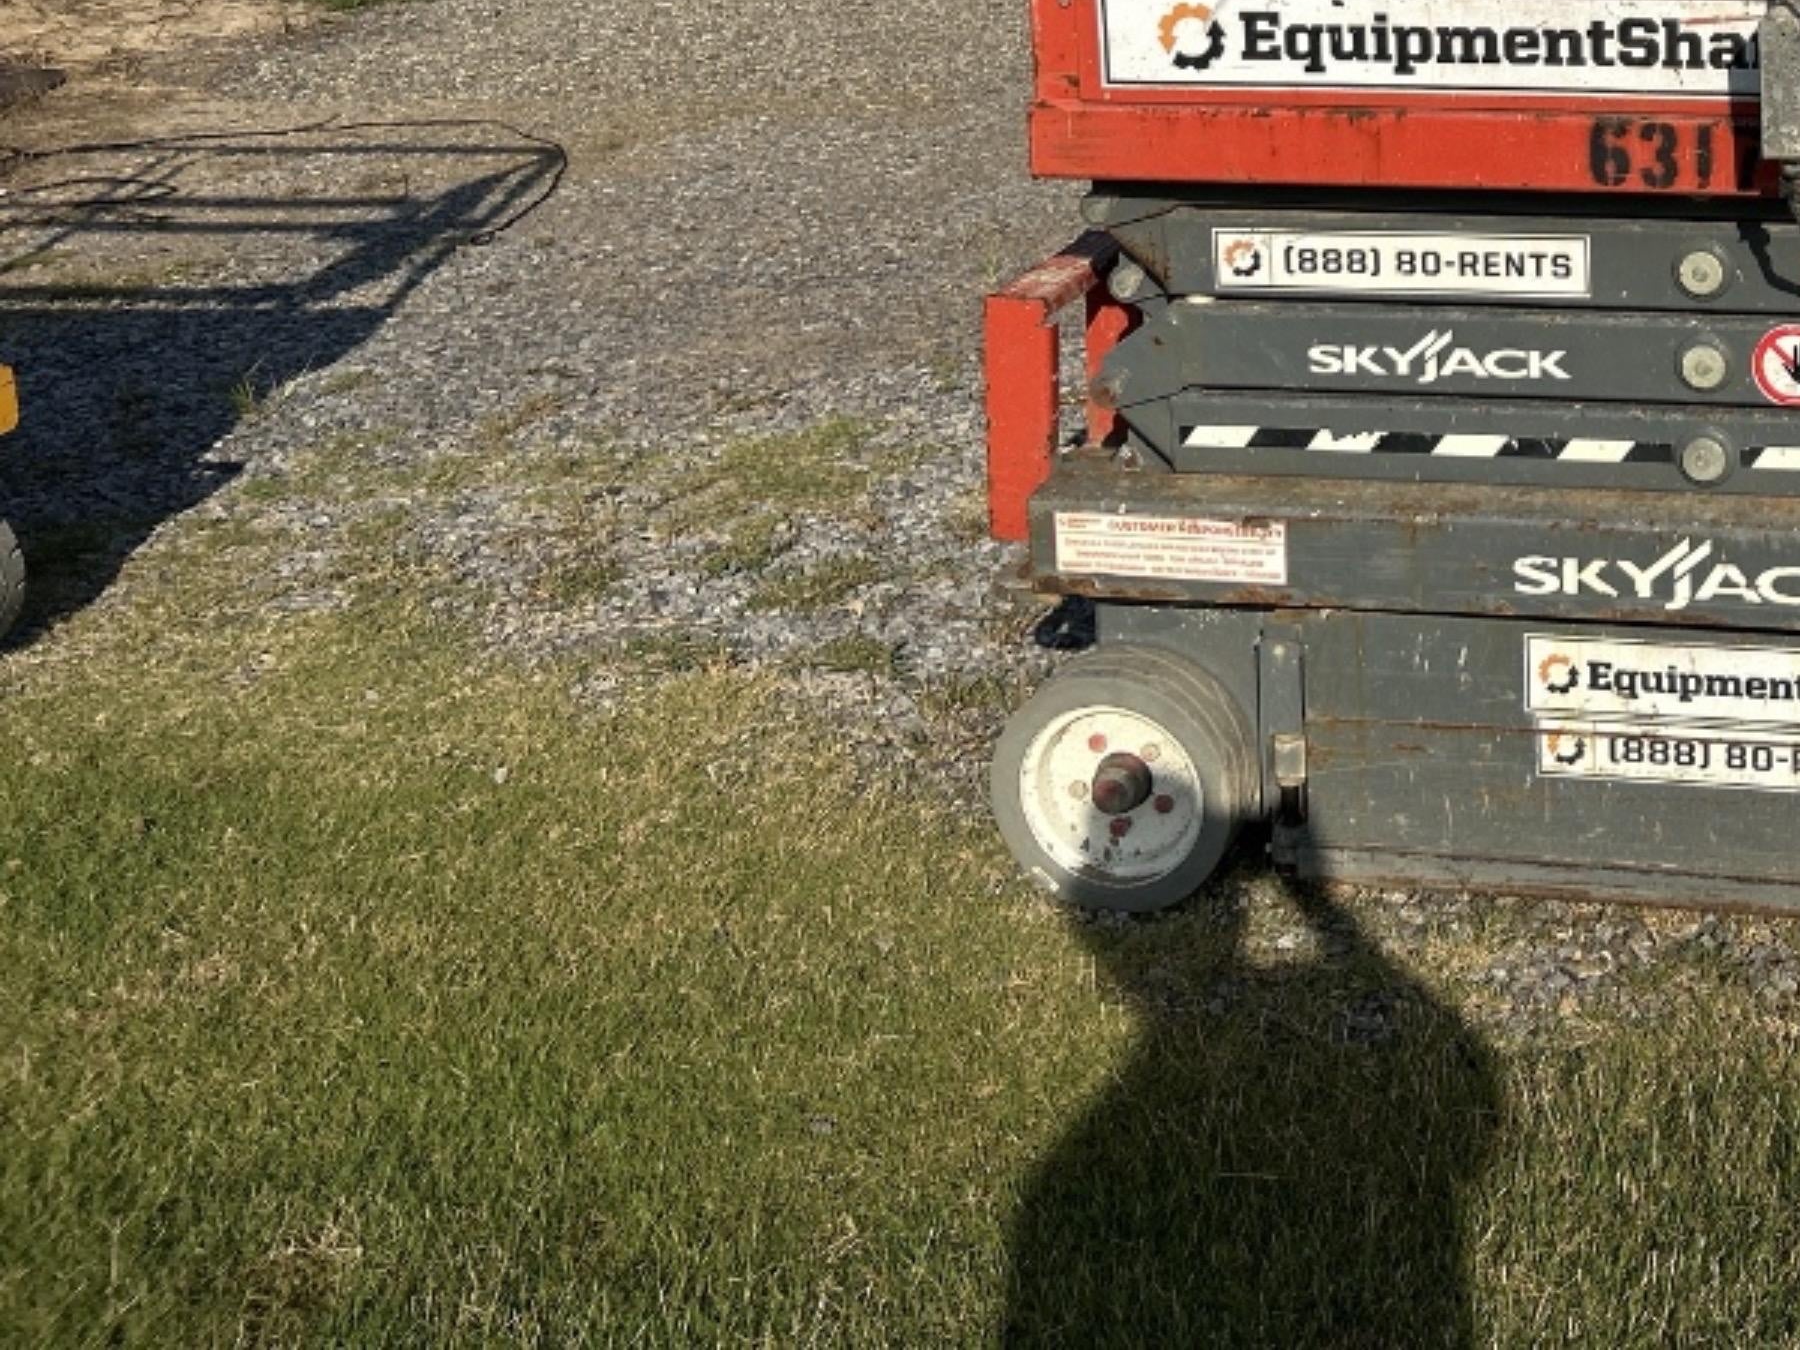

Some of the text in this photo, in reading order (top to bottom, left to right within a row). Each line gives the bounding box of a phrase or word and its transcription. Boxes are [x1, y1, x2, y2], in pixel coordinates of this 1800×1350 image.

[1238, 11, 1760, 75] EquipmentSha
[1588, 114, 1713, 189] 631
[1284, 245, 1573, 278] (888) 80-RENTS
[1306, 329, 1573, 385] SKYJACK
[1608, 736, 1711, 770] (888)
